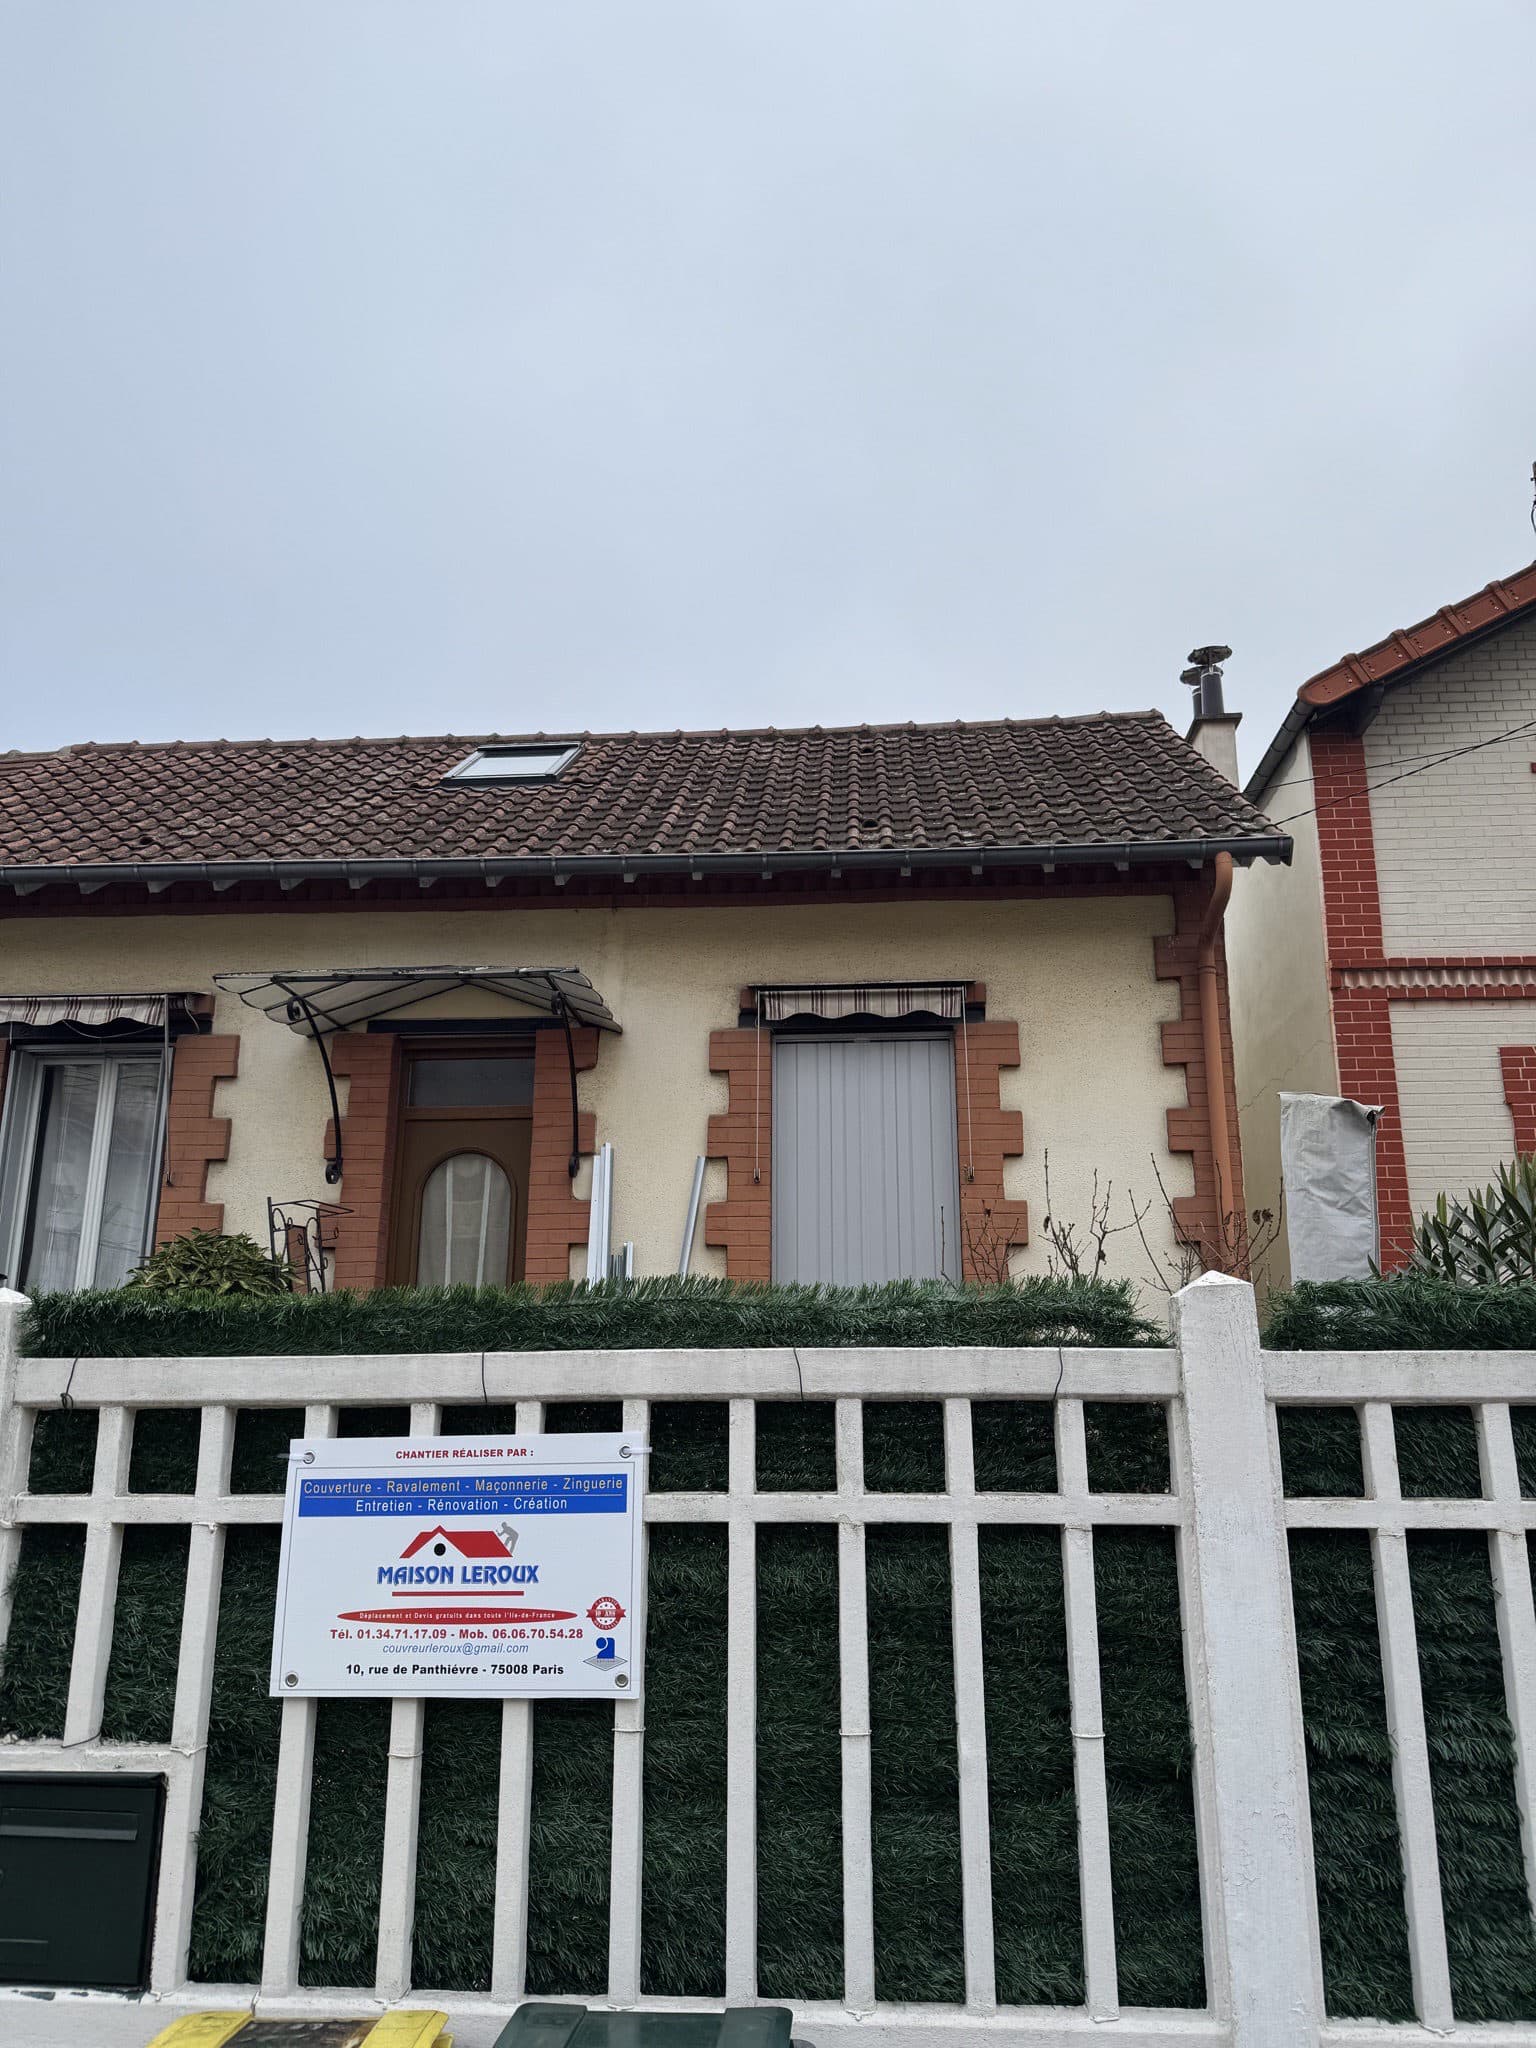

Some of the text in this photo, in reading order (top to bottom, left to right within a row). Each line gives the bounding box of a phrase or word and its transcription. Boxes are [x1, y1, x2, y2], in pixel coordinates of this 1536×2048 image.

[396, 1449, 449, 1459] CHANTIER
[452, 1447, 505, 1458] RÉALISER
[507, 1448, 527, 1457] PAR
[304, 1481, 372, 1494] Couverture
[386, 1480, 460, 1493] Ravalement
[475, 1478, 548, 1492] Maçonnerie
[563, 1477, 623, 1492] Zinguerie
[356, 1499, 412, 1512] Entretien
[428, 1498, 498, 1511] Rénovation
[513, 1497, 567, 1509] Création
[377, 1565, 539, 1586] MAISON LEROUX
[435, 1612, 462, 1621] gratuits
[330, 1629, 353, 1639] Tél.
[357, 1629, 447, 1639] 01.34.71.17.09
[459, 1629, 488, 1639] Mob.
[492, 1628, 583, 1639] 06.06.70.54.28
[382, 1642, 529, 1656] couvreurleroux@gmail.com
[346, 1664, 364, 1676] 10,
[368, 1666, 390, 1675] rue
[393, 1664, 408, 1675] de
[491, 1664, 528, 1674] 75008
[533, 1663, 564, 1675] Paris
